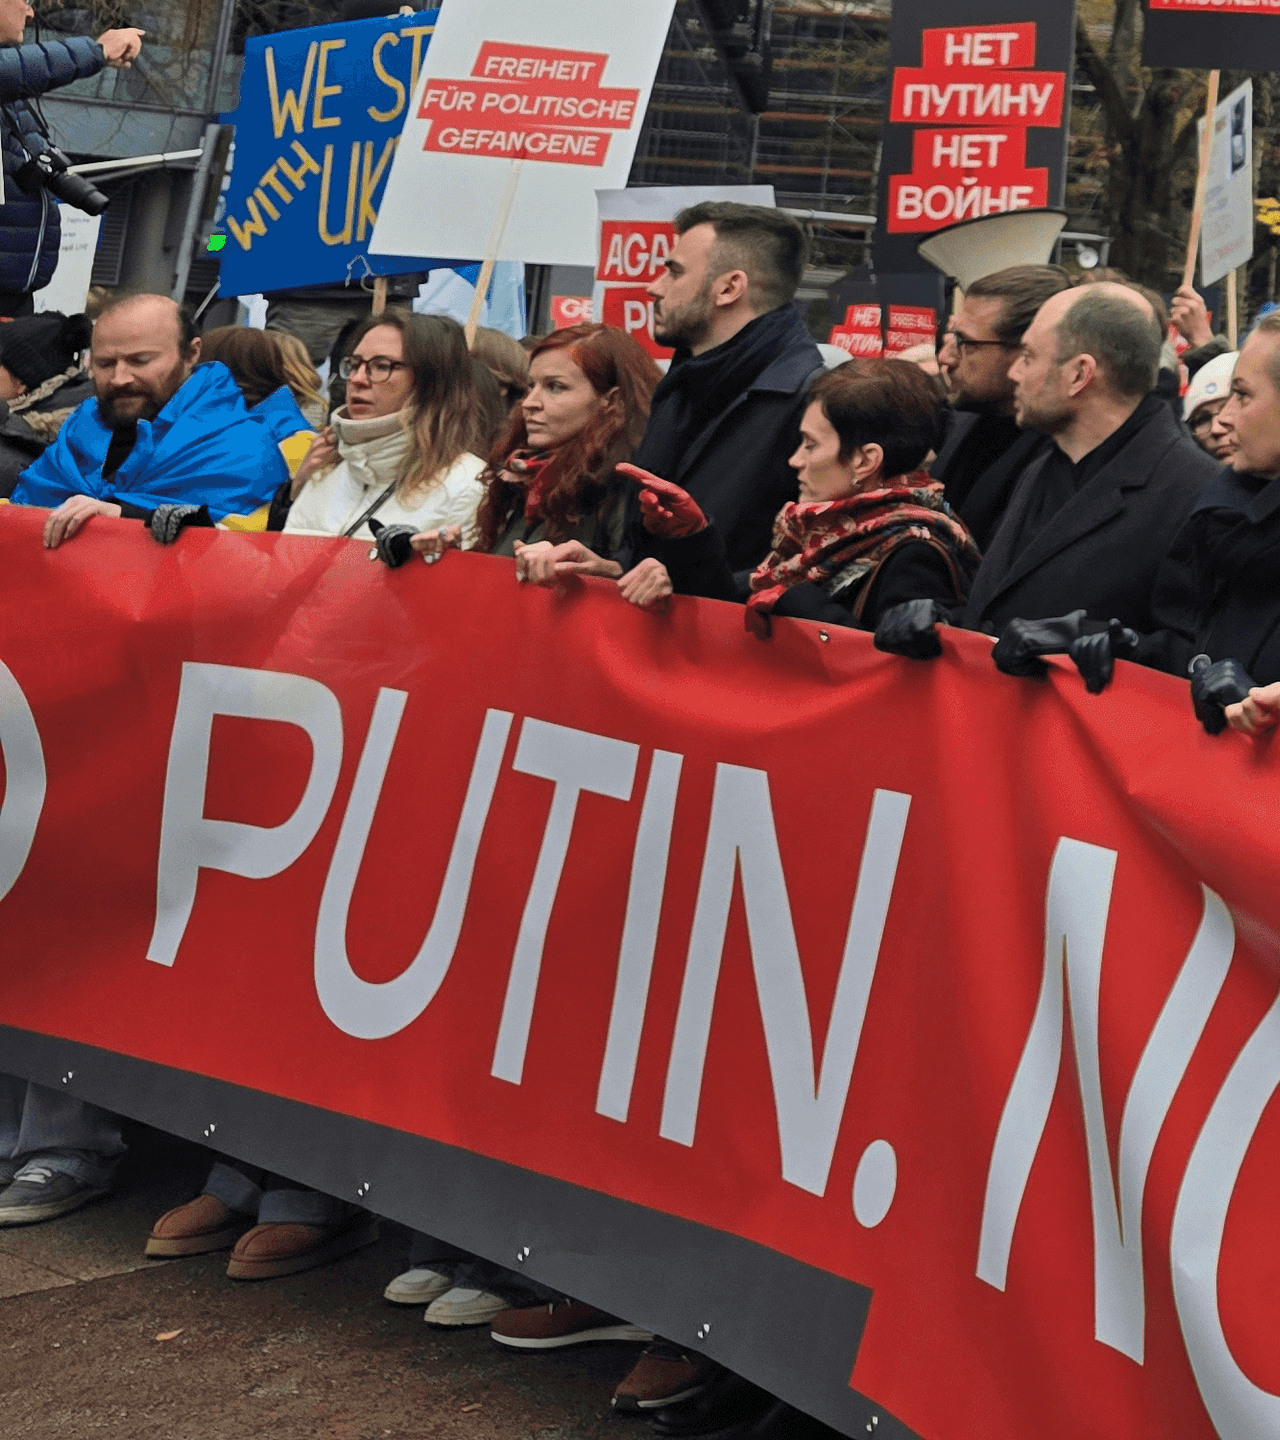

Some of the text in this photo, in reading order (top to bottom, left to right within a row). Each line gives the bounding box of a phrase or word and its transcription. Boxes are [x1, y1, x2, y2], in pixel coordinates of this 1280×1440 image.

[944, 31, 1020, 67] НЕТ
[265, 25, 437, 140] WE ST
[483, 55, 597, 82] FREIHEIT
[423, 84, 635, 122] FÜR POLITISCHE
[902, 82, 1055, 117] ПУТИНУ
[437, 126, 601, 157] GEFANGENE
[932, 133, 1009, 169] НЕТ
[226, 138, 322, 251] WITH
[896, 176, 1034, 221] ВОЙНЕ
[146, 661, 911, 1228] PUTIN.
